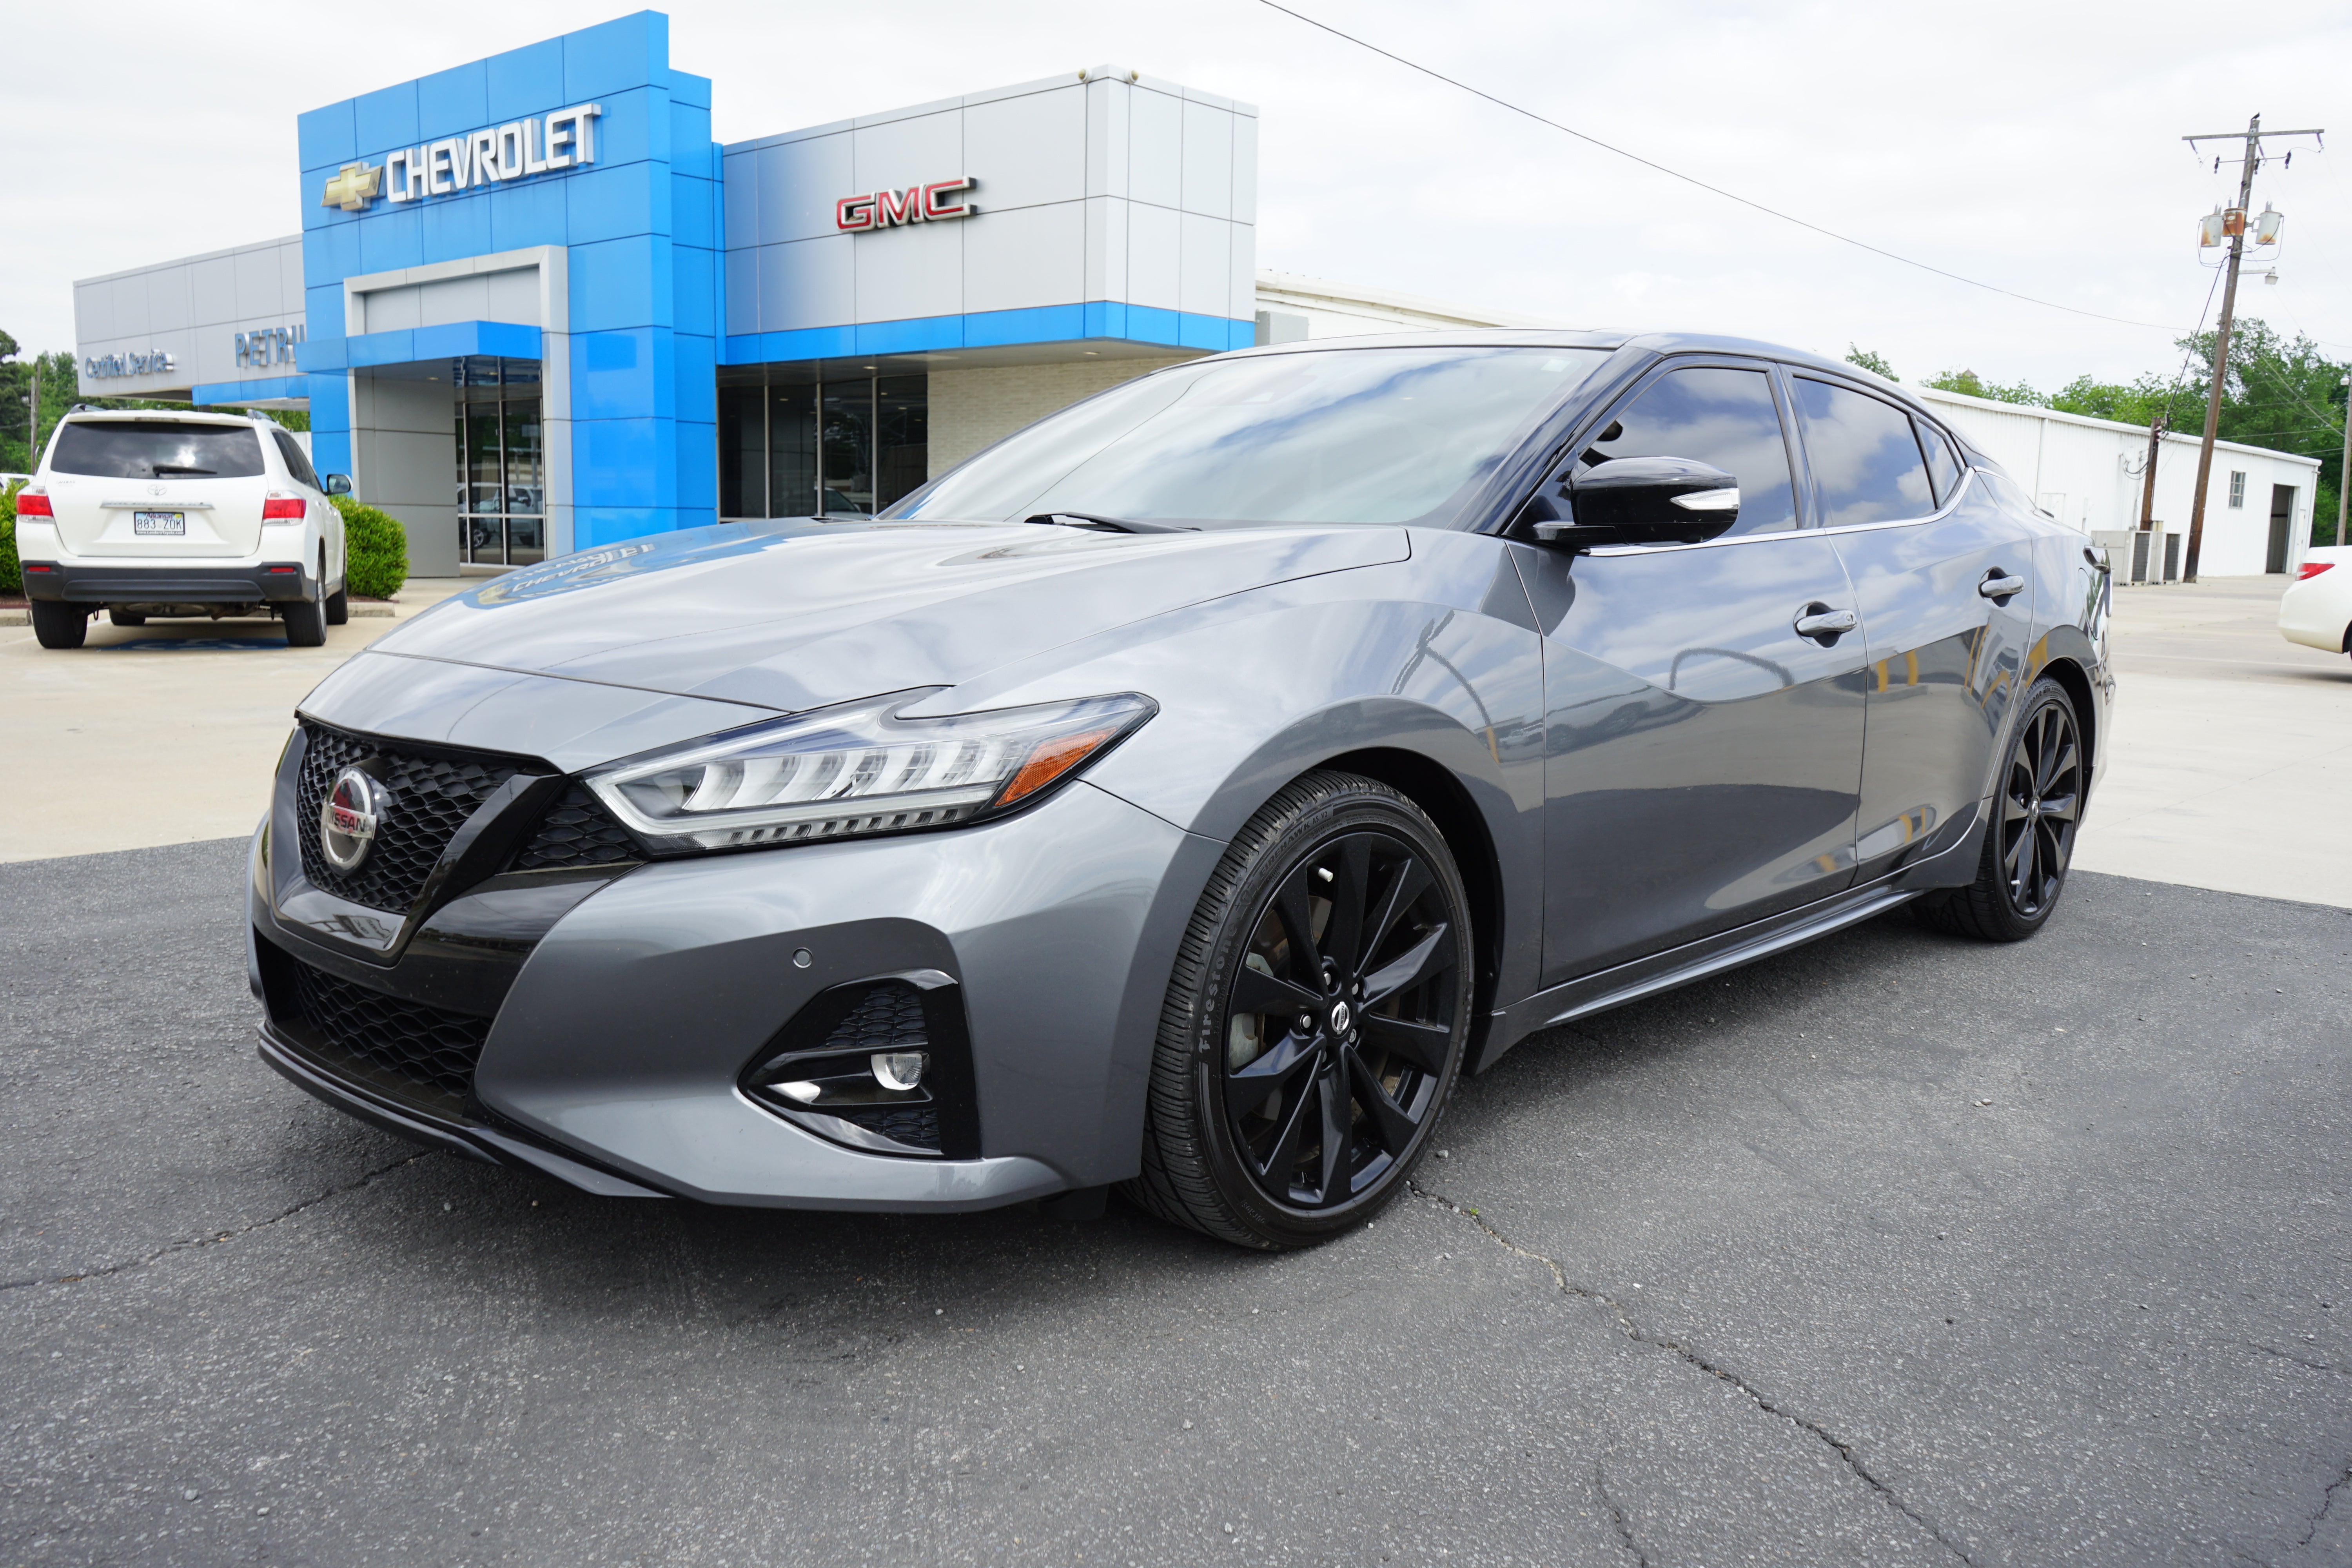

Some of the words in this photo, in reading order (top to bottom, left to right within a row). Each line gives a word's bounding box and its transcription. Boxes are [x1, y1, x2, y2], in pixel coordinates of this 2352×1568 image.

[386, 103, 600, 203] CHEVROLET
[836, 176, 976, 233] GMC
[85, 352, 126, 379] Certified
[129, 348, 169, 375] Service
[137, 519, 156, 530] 883
[327, 810, 366, 832] NISSAN
[1259, 822, 1310, 877] FIREHAWK
[1312, 815, 1319, 824] AS
[1198, 924, 1237, 1053] Firestone
